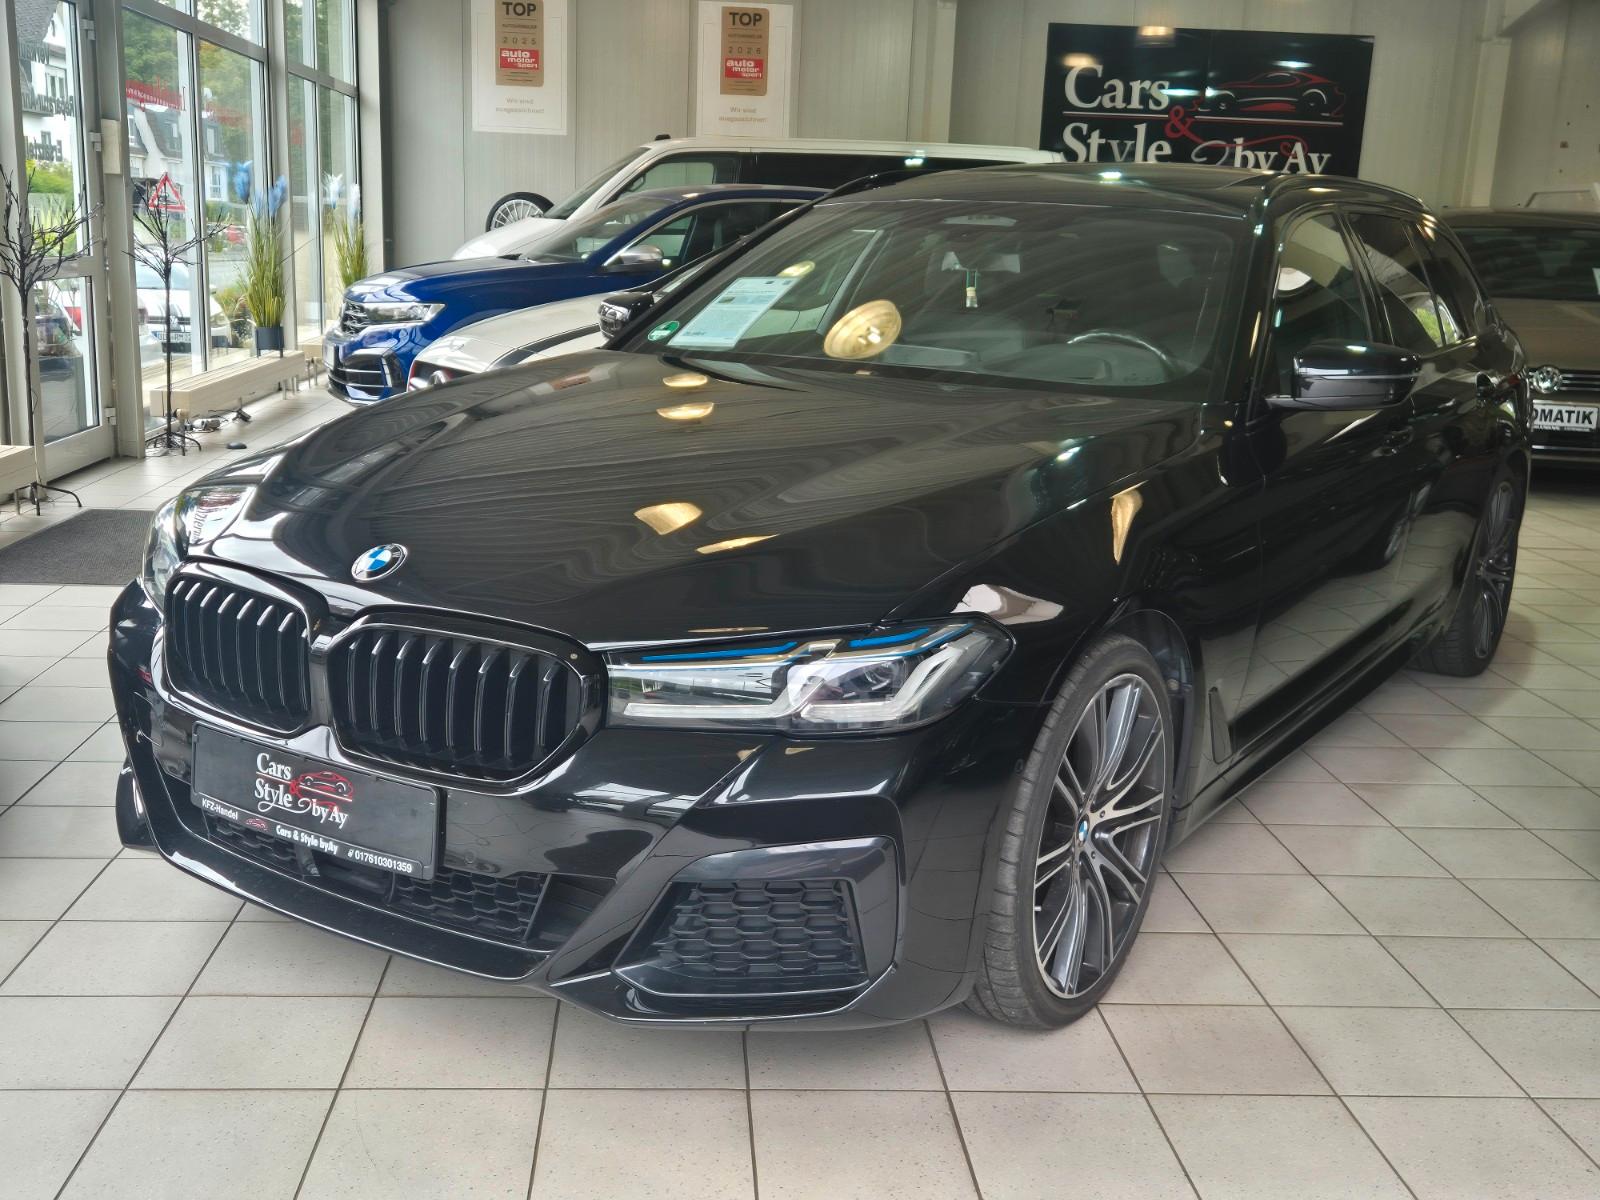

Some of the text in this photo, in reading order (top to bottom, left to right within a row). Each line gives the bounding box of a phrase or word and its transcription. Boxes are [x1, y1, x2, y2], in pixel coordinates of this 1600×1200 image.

[502, 2, 537, 17] TOP
[729, 12, 762, 26] TOP
[501, 50, 531, 58] auto
[726, 59, 755, 67] auto
[1065, 64, 1170, 110] Cars
[1164, 105, 1195, 139] &
[1060, 122, 1172, 163] Style
[256, 752, 292, 780] Cars
[254, 778, 293, 809] Style
[202, 798, 239, 820] KFZ-Handel
[276, 825, 292, 839] Cars
[293, 830, 300, 841] &
[300, 832, 319, 847] Style
[354, 851, 413, 874] 017610301359
